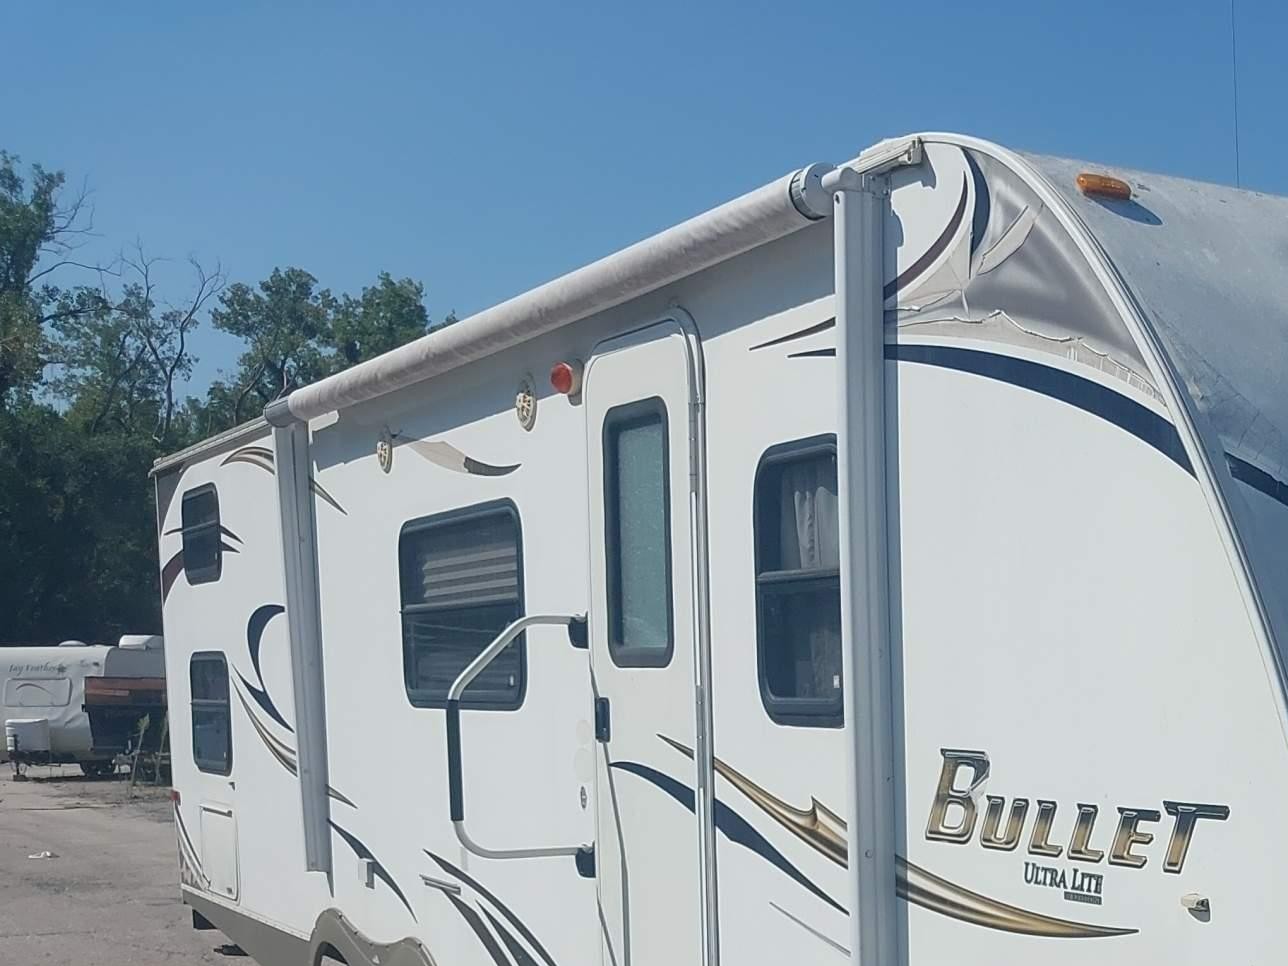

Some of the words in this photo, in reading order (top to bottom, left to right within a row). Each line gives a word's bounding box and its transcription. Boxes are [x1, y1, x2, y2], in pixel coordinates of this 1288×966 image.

[924, 747, 1231, 875] BULLET
[1024, 862, 1067, 890] ULTRA
[1071, 867, 1103, 895] LITE
